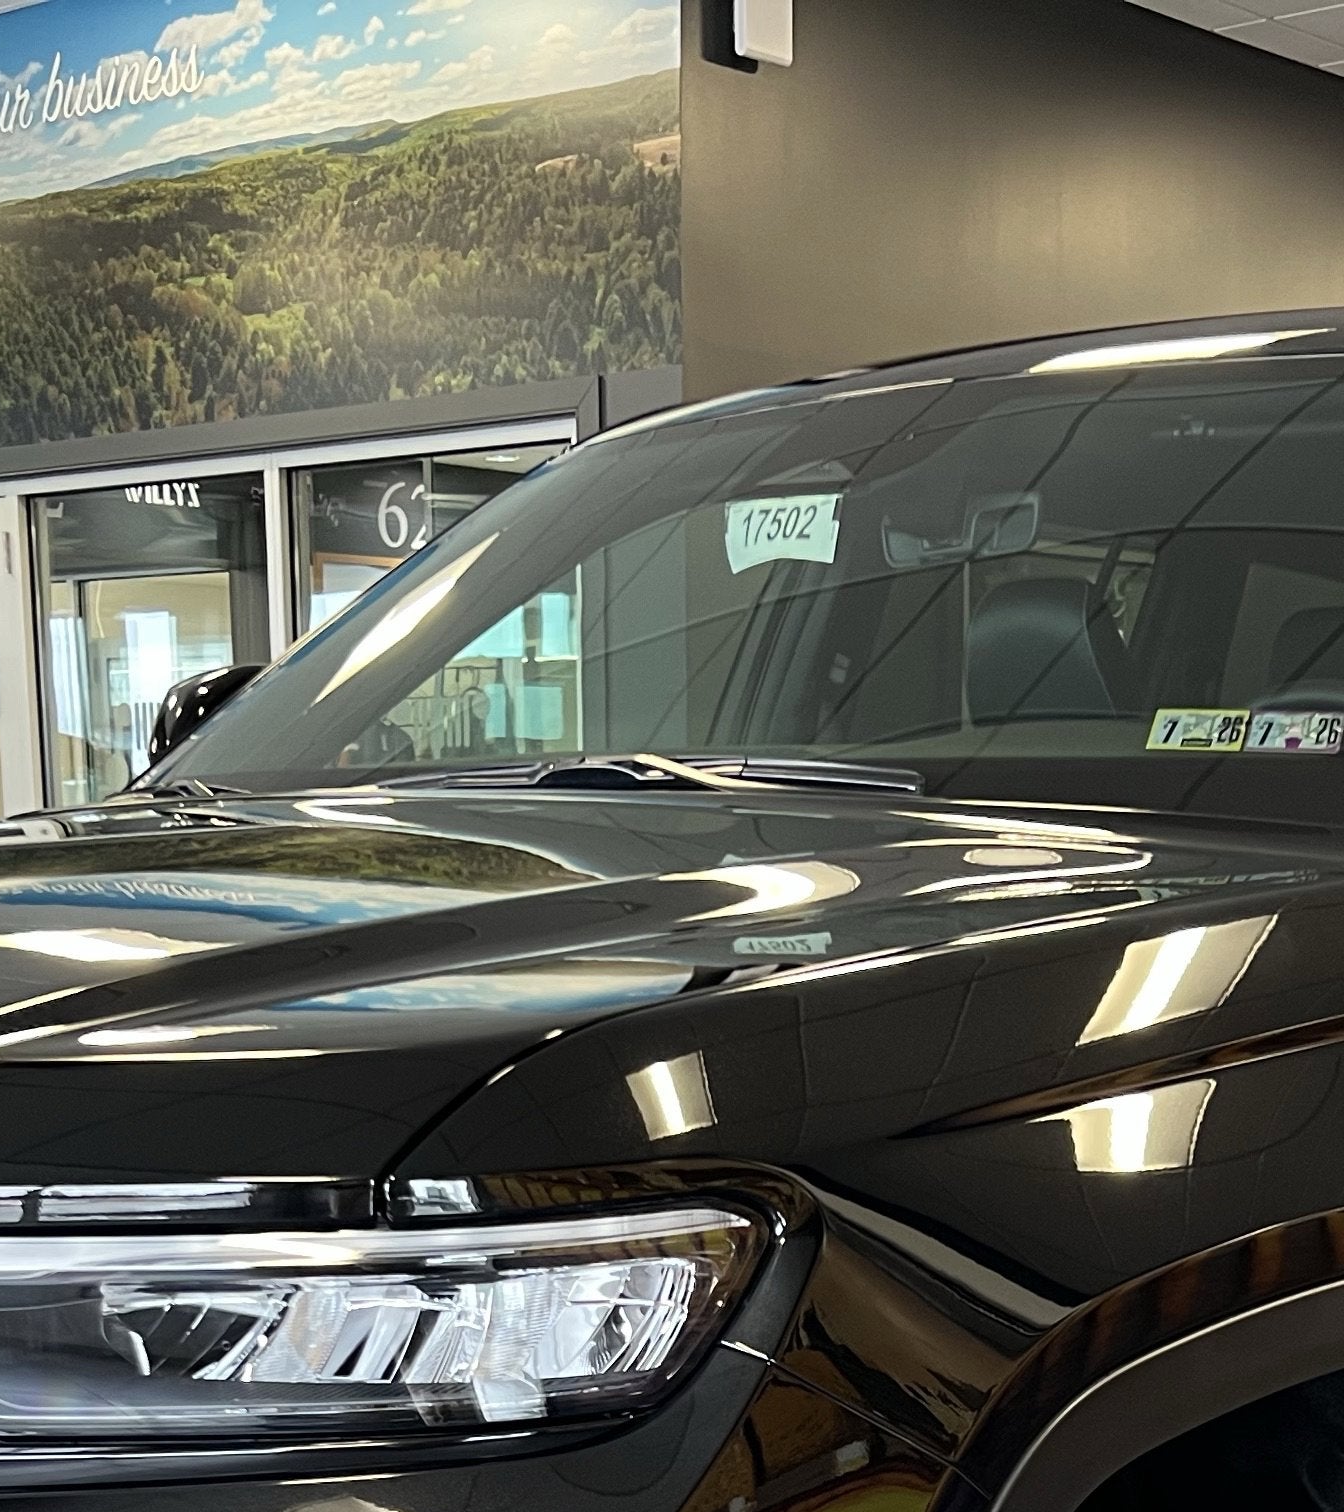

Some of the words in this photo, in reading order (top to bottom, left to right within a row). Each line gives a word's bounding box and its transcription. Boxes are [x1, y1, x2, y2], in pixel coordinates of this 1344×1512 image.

[42, 44, 205, 123] business
[743, 504, 818, 547] 17502
[1162, 719, 1179, 744] 7
[1216, 716, 1245, 743] 26
[1258, 721, 1274, 746] 7
[1314, 717, 1341, 745] 26
